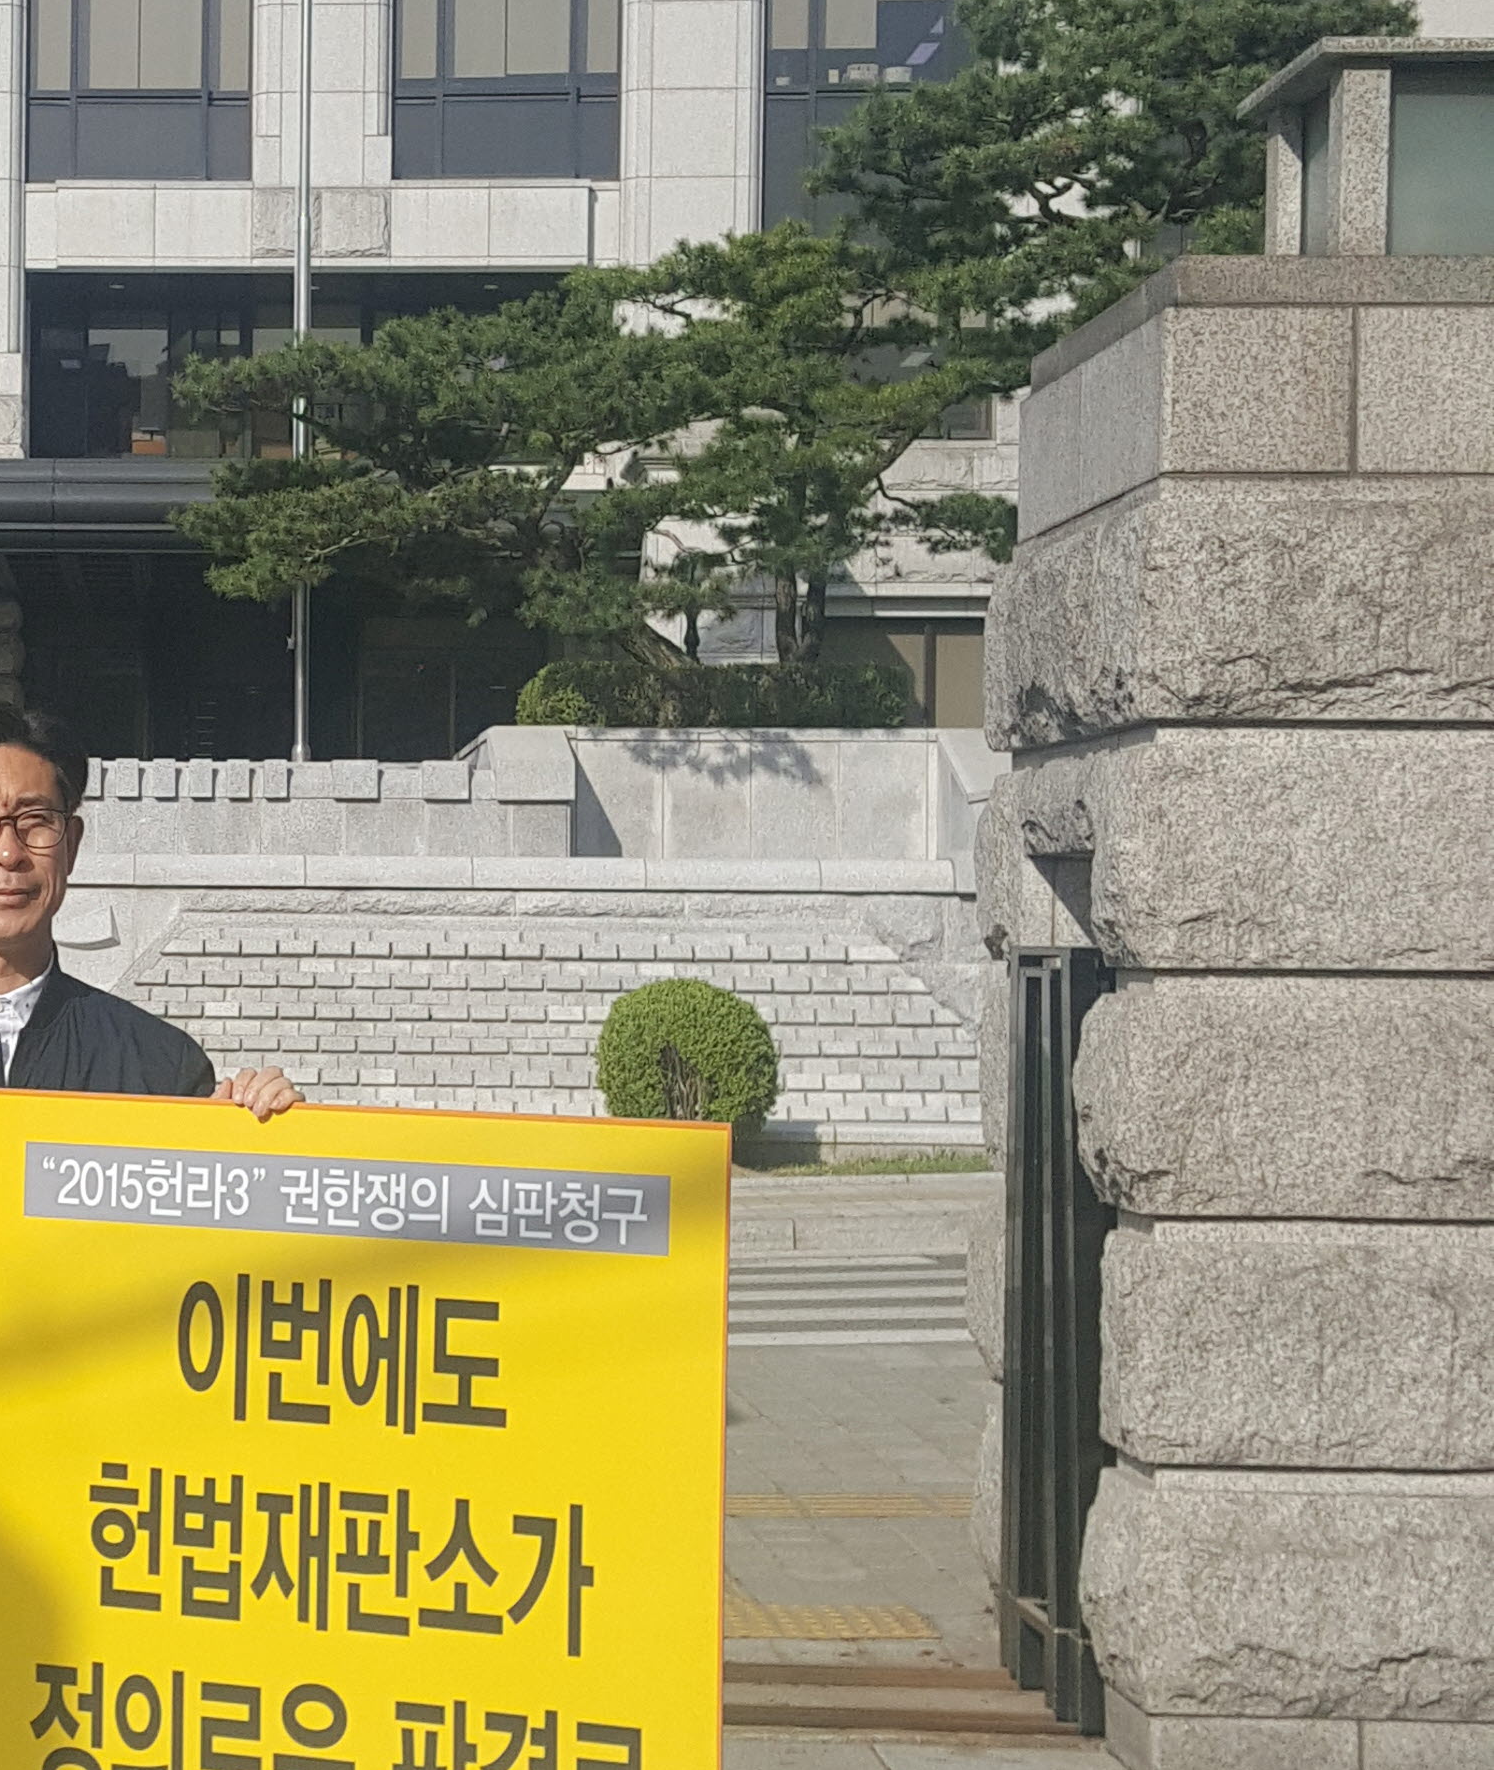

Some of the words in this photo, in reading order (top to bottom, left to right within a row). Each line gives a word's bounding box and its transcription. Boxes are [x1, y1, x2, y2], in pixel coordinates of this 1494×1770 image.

[280, 1166, 449, 1235] 권한쟁의
[469, 1178, 649, 1246] 심판청구
[179, 1274, 505, 1433] 이번에도
[91, 1464, 592, 1655] 헌법재판소가
